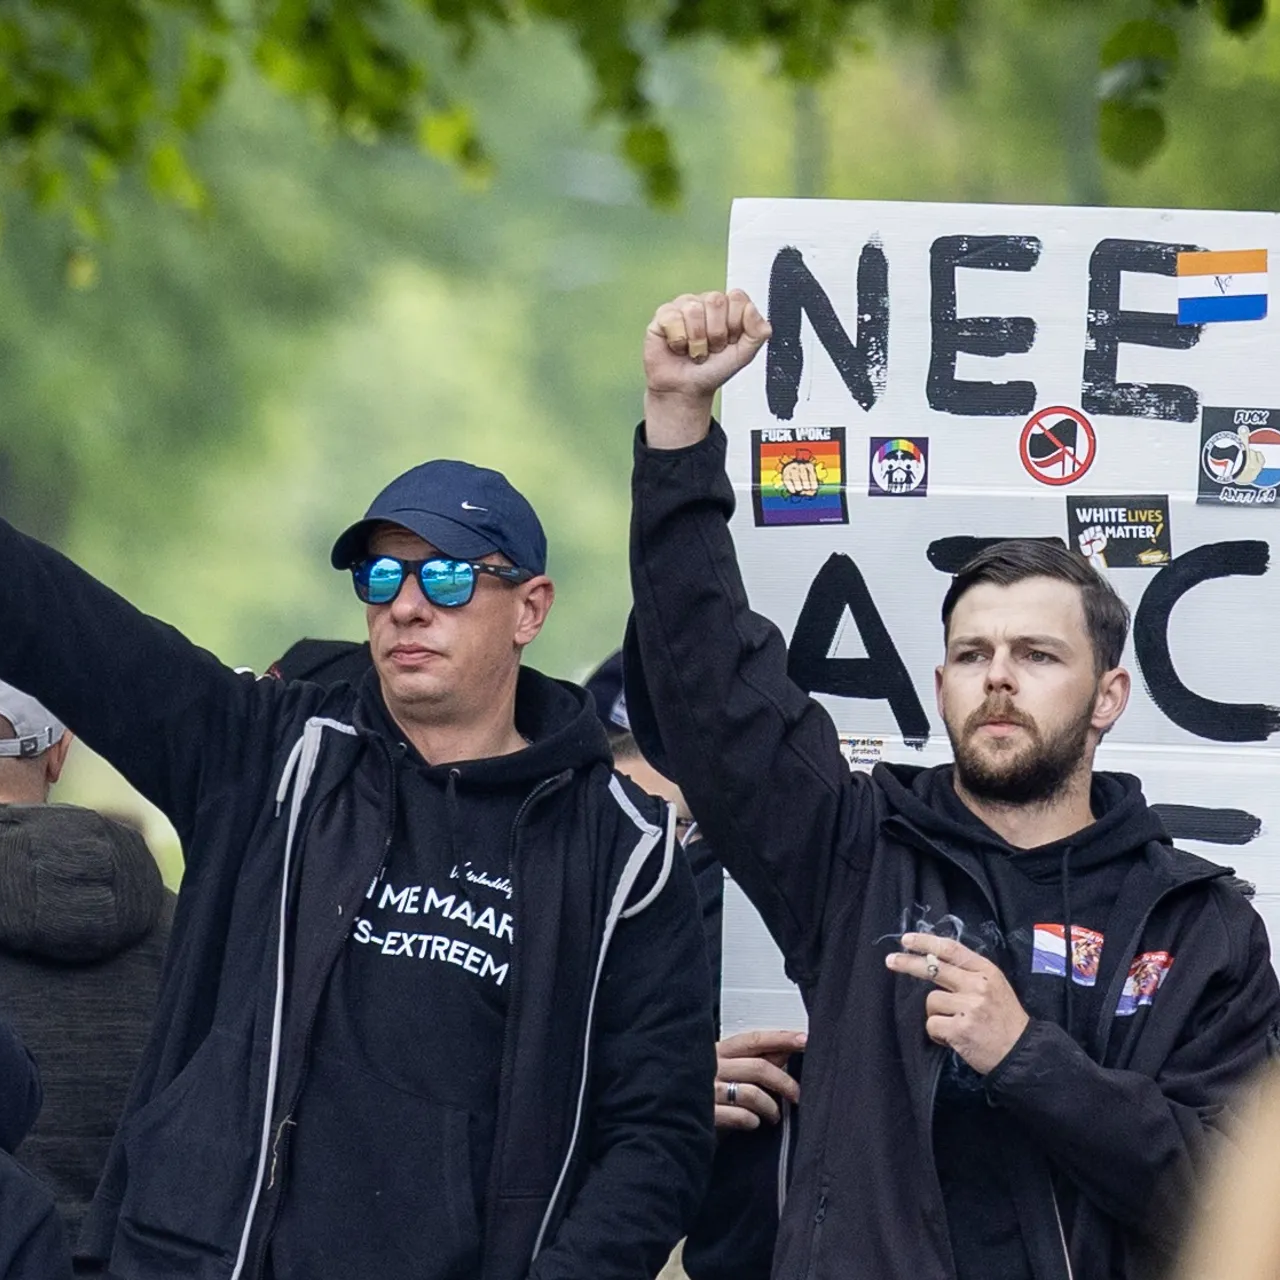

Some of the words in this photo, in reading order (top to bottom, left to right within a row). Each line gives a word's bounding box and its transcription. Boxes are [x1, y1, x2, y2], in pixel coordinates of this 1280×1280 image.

[764, 232, 1212, 424] NEE
[1233, 409, 1270, 425] FUCK
[761, 429, 793, 442] FUCK
[795, 427, 831, 441] WOKE
[1076, 507, 1127, 523] WHITE
[1127, 509, 1163, 522] LIVES
[1105, 522, 1164, 544] MATTER!
[423, 886, 514, 945] MAAR
[352, 918, 510, 986] S-EXTREEM
